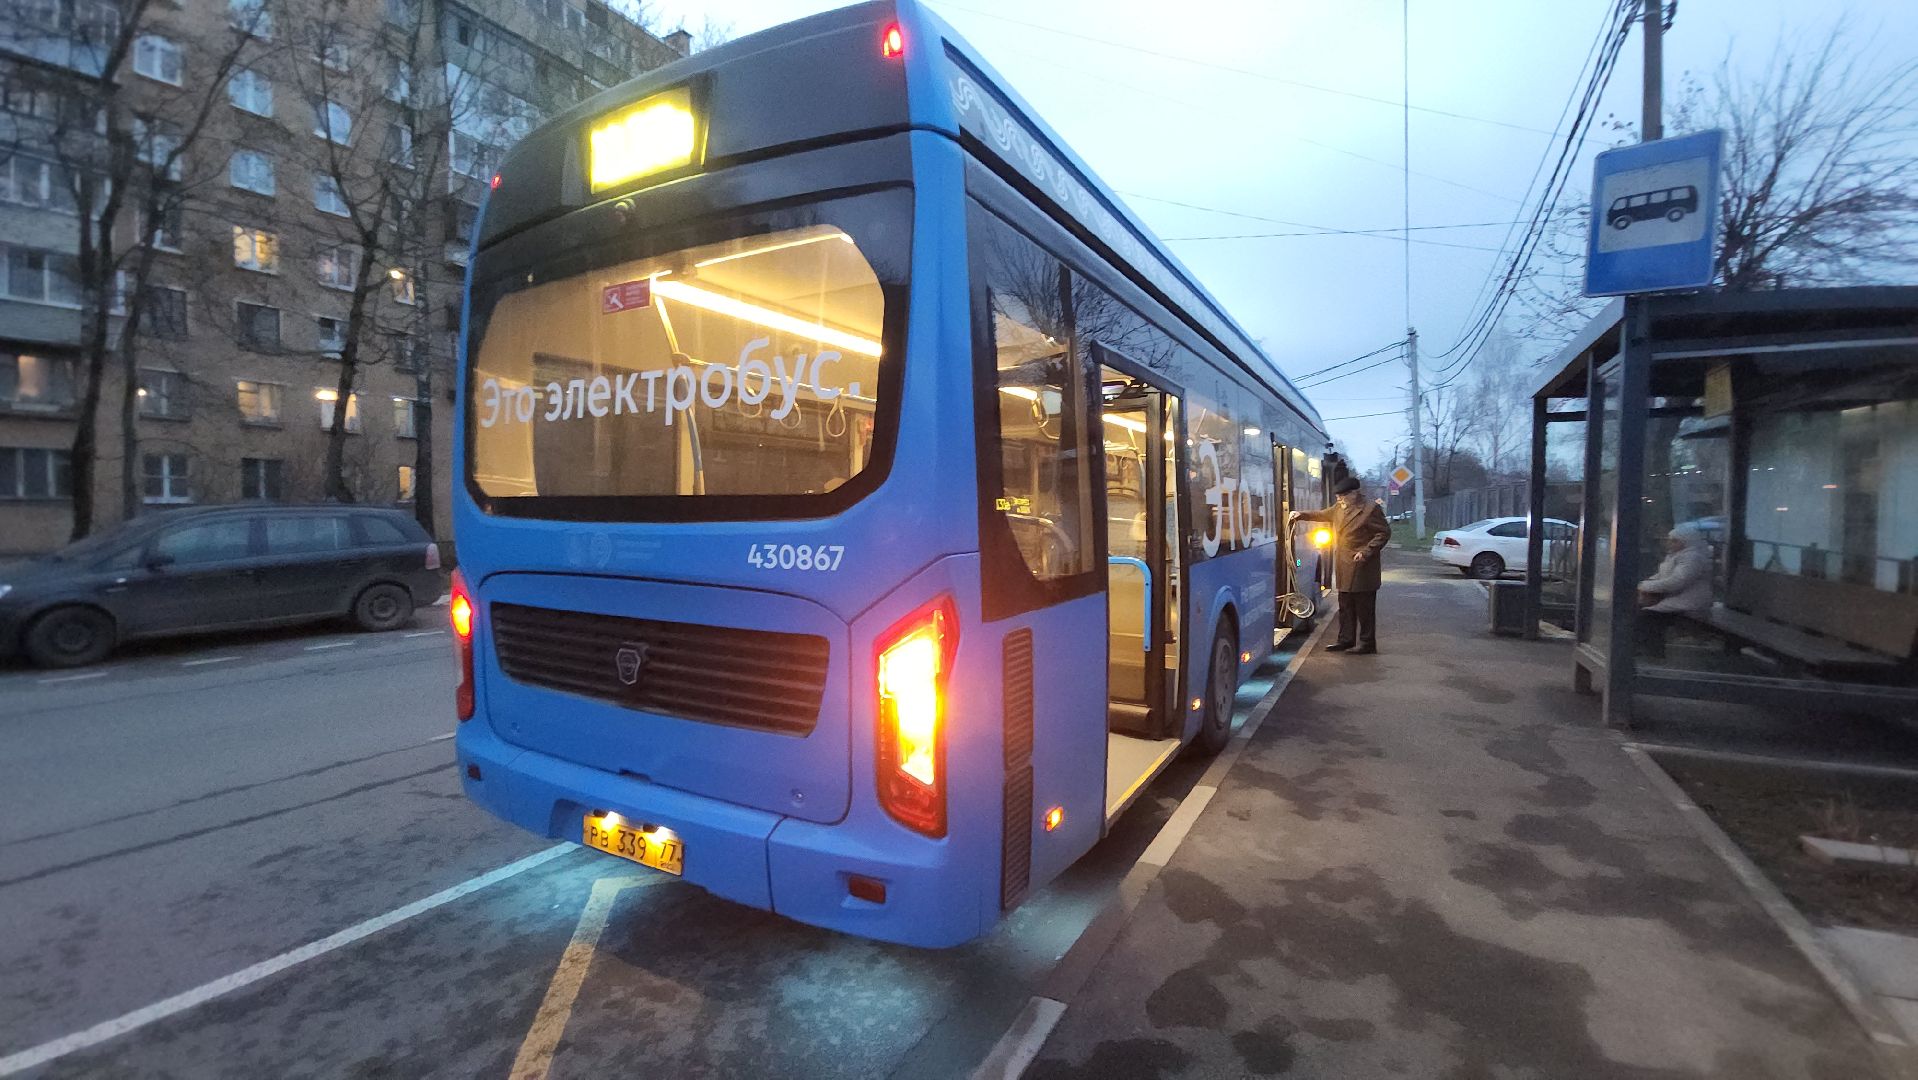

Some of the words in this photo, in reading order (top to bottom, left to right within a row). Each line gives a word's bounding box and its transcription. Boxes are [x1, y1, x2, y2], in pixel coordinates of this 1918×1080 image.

[480, 378, 535, 428] Это
[544, 336, 860, 426] электробус.
[1199, 439, 1252, 558] Это
[747, 543, 845, 571] 430867
[617, 830, 646, 859] 339
